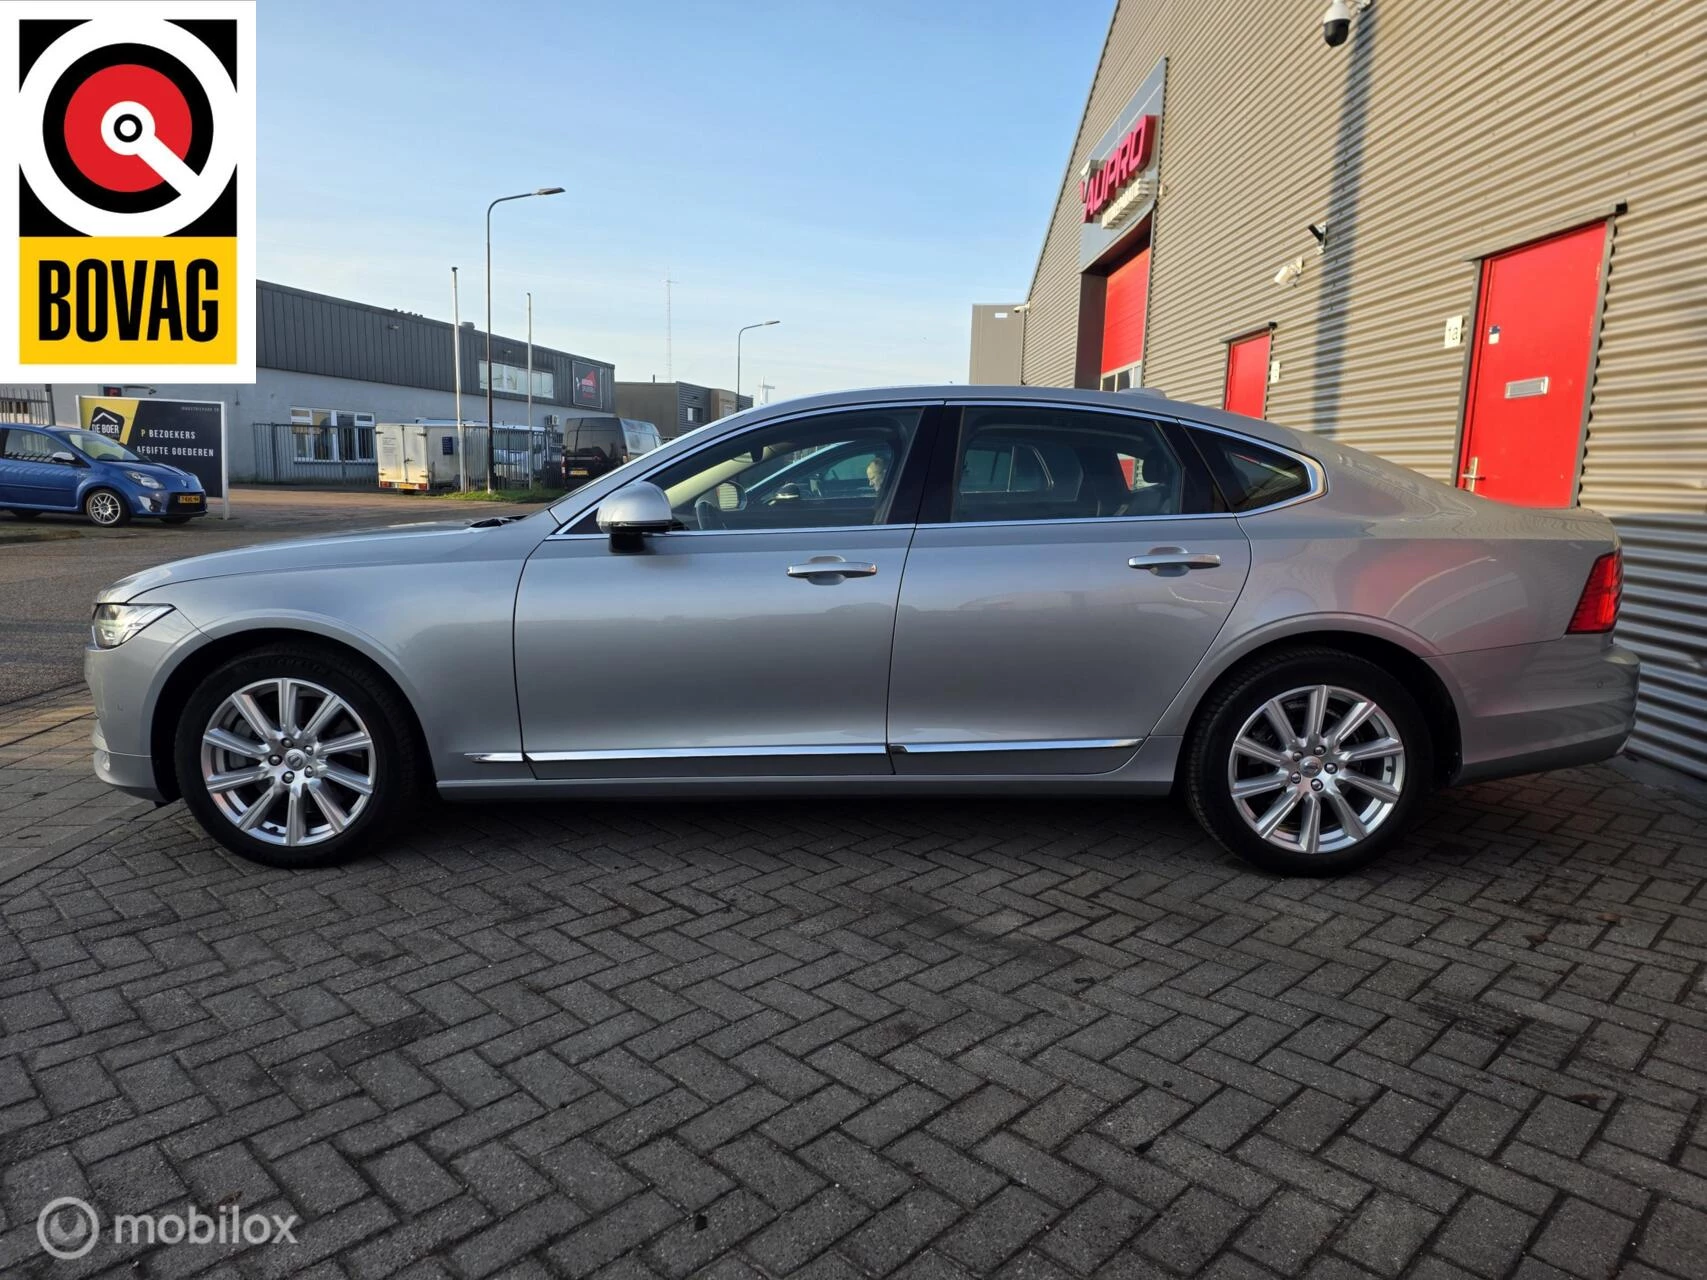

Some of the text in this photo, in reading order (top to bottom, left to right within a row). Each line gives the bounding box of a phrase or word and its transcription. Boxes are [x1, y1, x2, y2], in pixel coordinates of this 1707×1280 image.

[101, 424, 120, 434] BOER
[140, 428, 196, 440] P BEZOEKERS
[136, 445, 214, 457] AFGIFTE GOEDEREN
